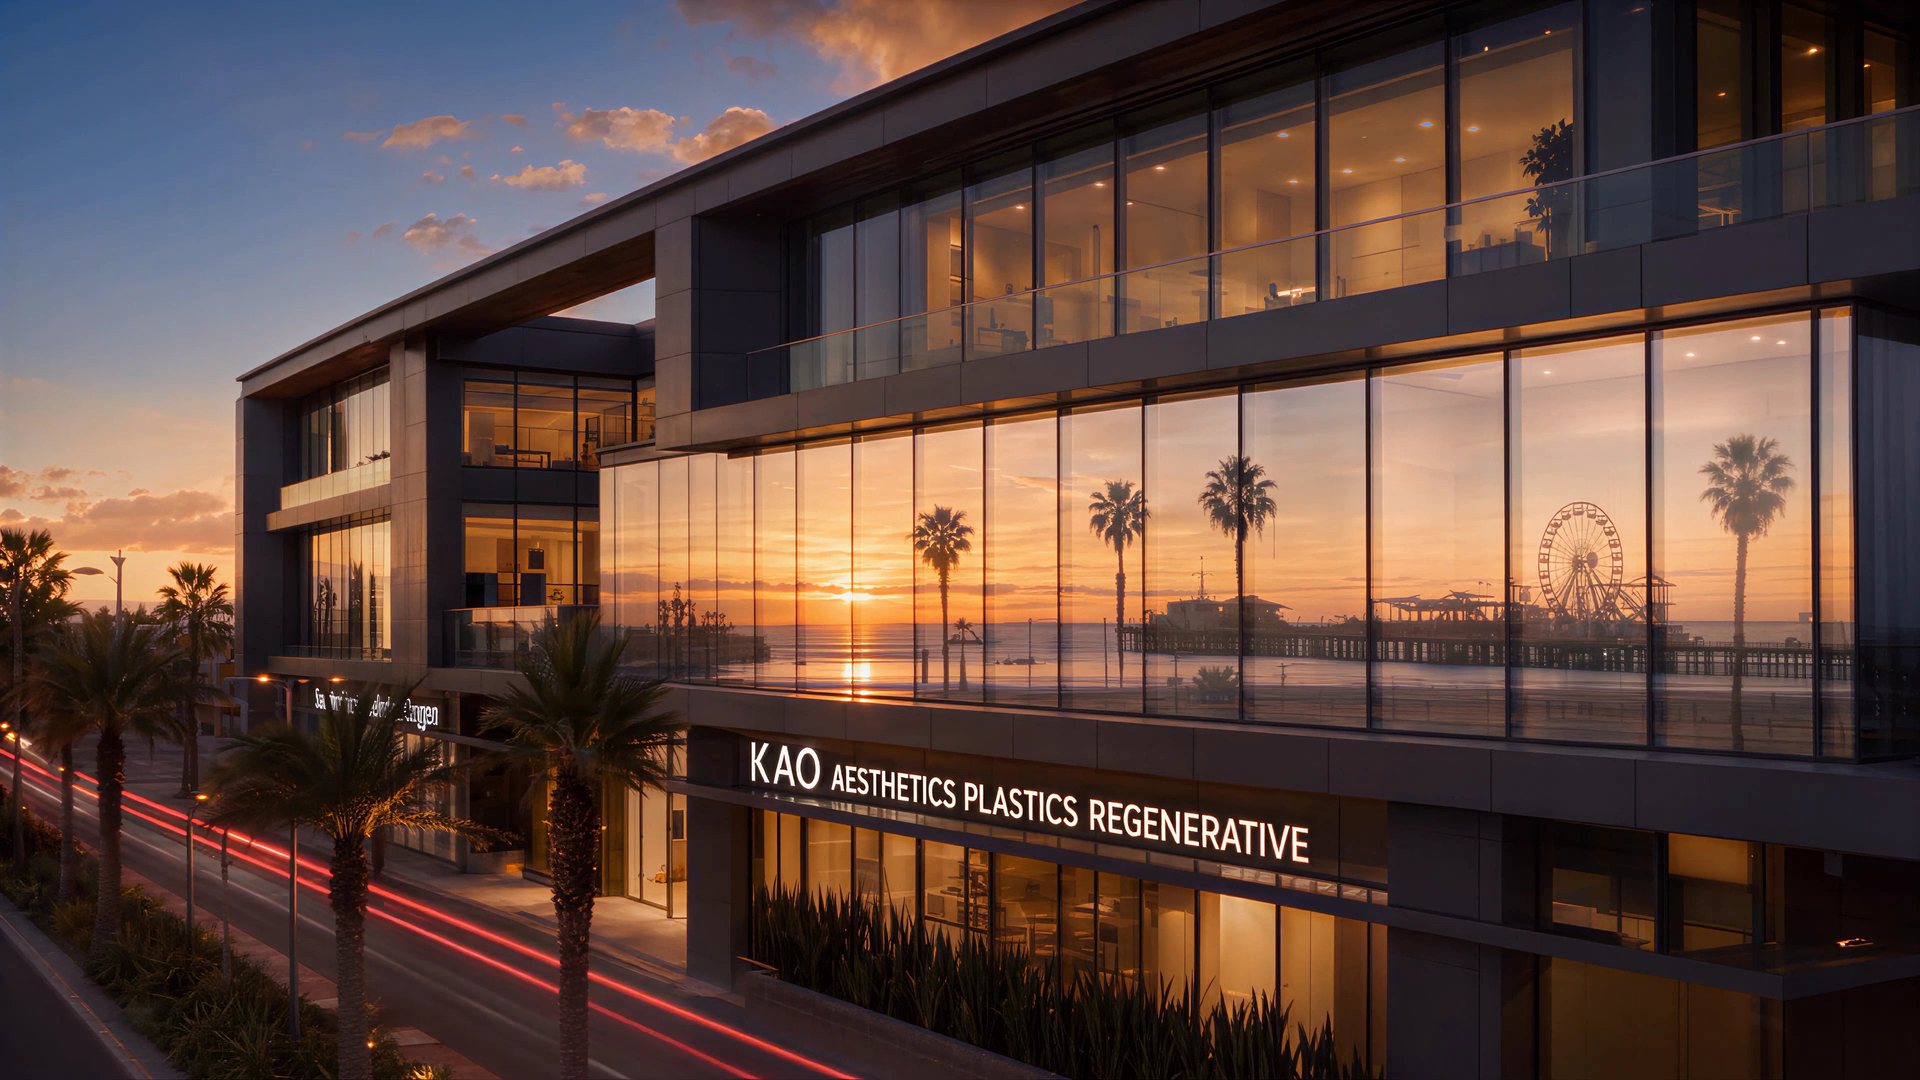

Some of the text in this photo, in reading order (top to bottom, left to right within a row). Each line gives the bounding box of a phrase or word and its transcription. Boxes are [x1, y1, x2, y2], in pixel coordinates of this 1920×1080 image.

[751, 741, 1309, 864] KAO AESTHETICS PLASTICS REGENERATIVE
